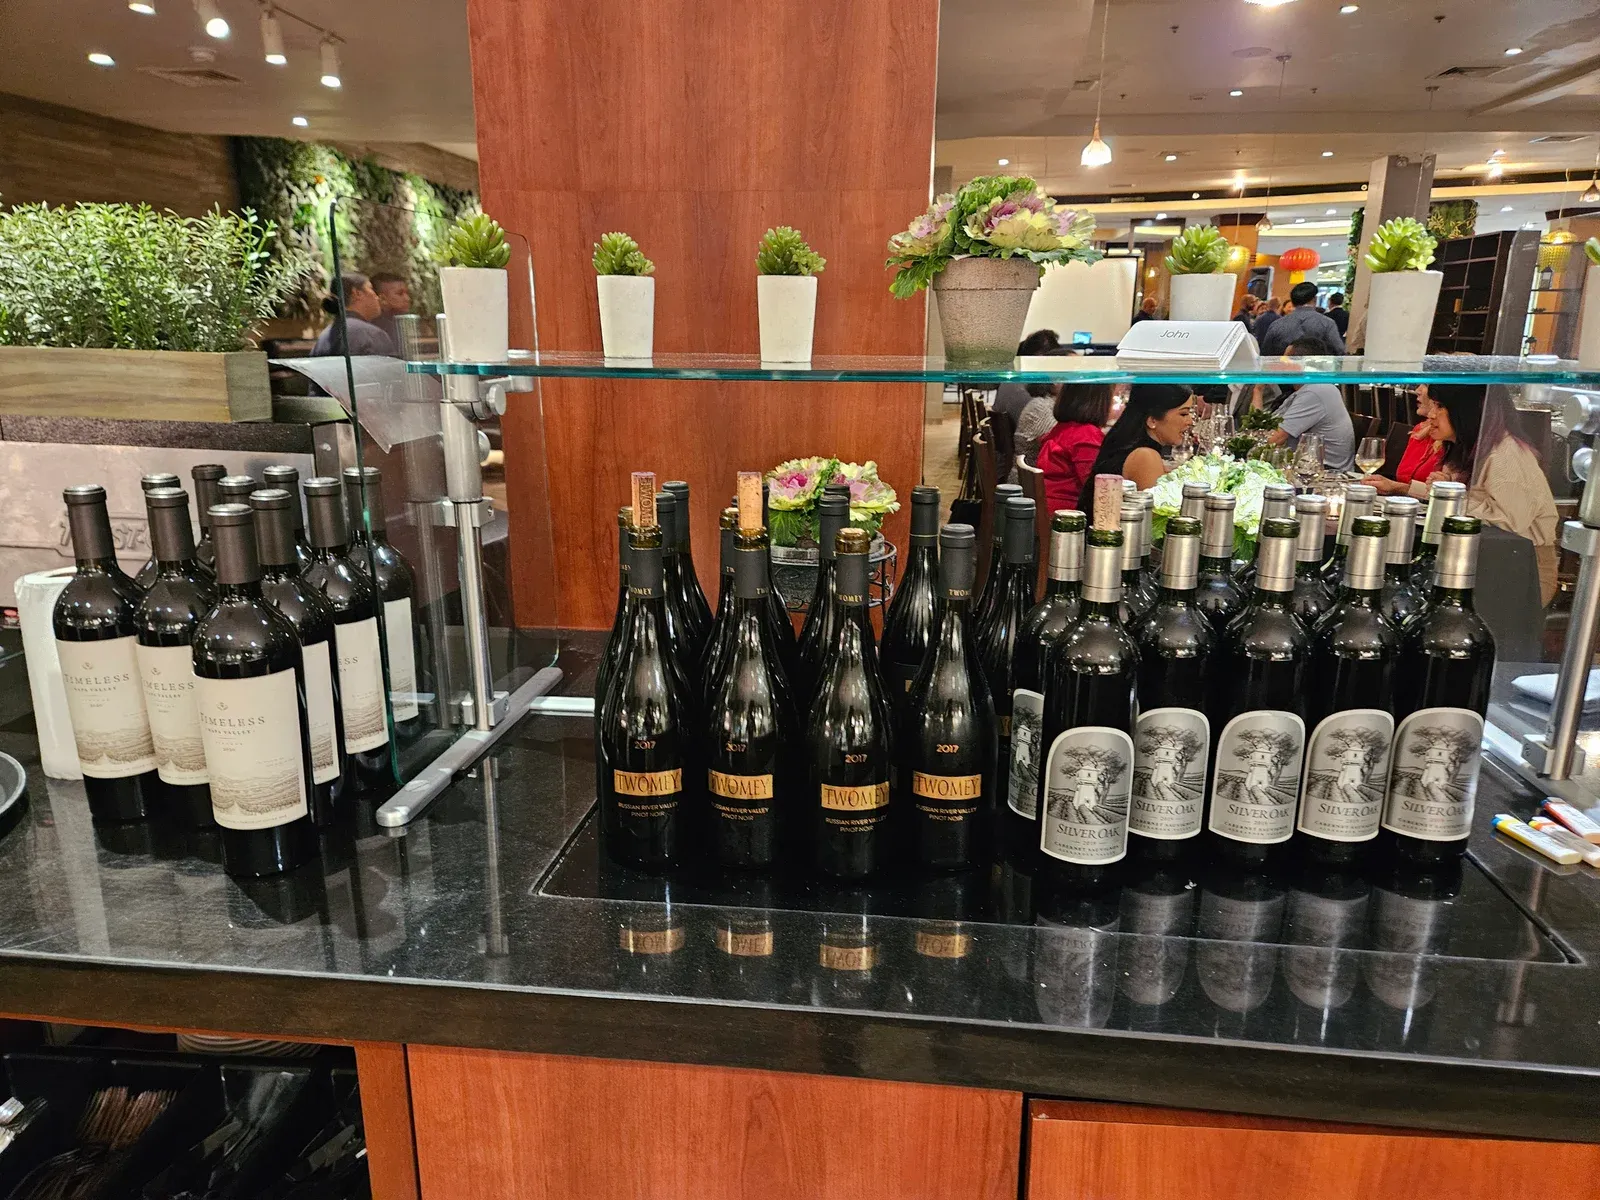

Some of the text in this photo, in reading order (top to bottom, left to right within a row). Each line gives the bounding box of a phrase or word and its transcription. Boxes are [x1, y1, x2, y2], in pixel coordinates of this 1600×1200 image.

[1160, 329, 1190, 339] John
[63, 673, 130, 685] TIMELESS
[200, 712, 265, 727] TIMELESS
[634, 740, 657, 750] 2017
[725, 743, 747, 752] 2017
[936, 744, 960, 753] 2017
[845, 754, 868, 763] 2017
[616, 773, 680, 793] TWOMEY
[710, 773, 770, 796] TWOMEY
[915, 775, 979, 797] TWOMEY
[825, 784, 887, 807] TWOMEY
[618, 801, 678, 811] RUSSIAN RIVER VALLEY
[749, 807, 770, 815] VALLEY
[1135, 800, 1196, 815] SILVER OAK
[1227, 804, 1290, 819] SILVER OAK
[1318, 802, 1379, 817] SILVER OAK
[1401, 800, 1467, 816] SILVER OAK
[721, 812, 740, 820] PINOT
[825, 818, 850, 826] RUSSIAN
[851, 818, 869, 826] RIVER
[1056, 823, 1120, 839] SILVER OAK
[1054, 841, 1086, 851] CABERNET
